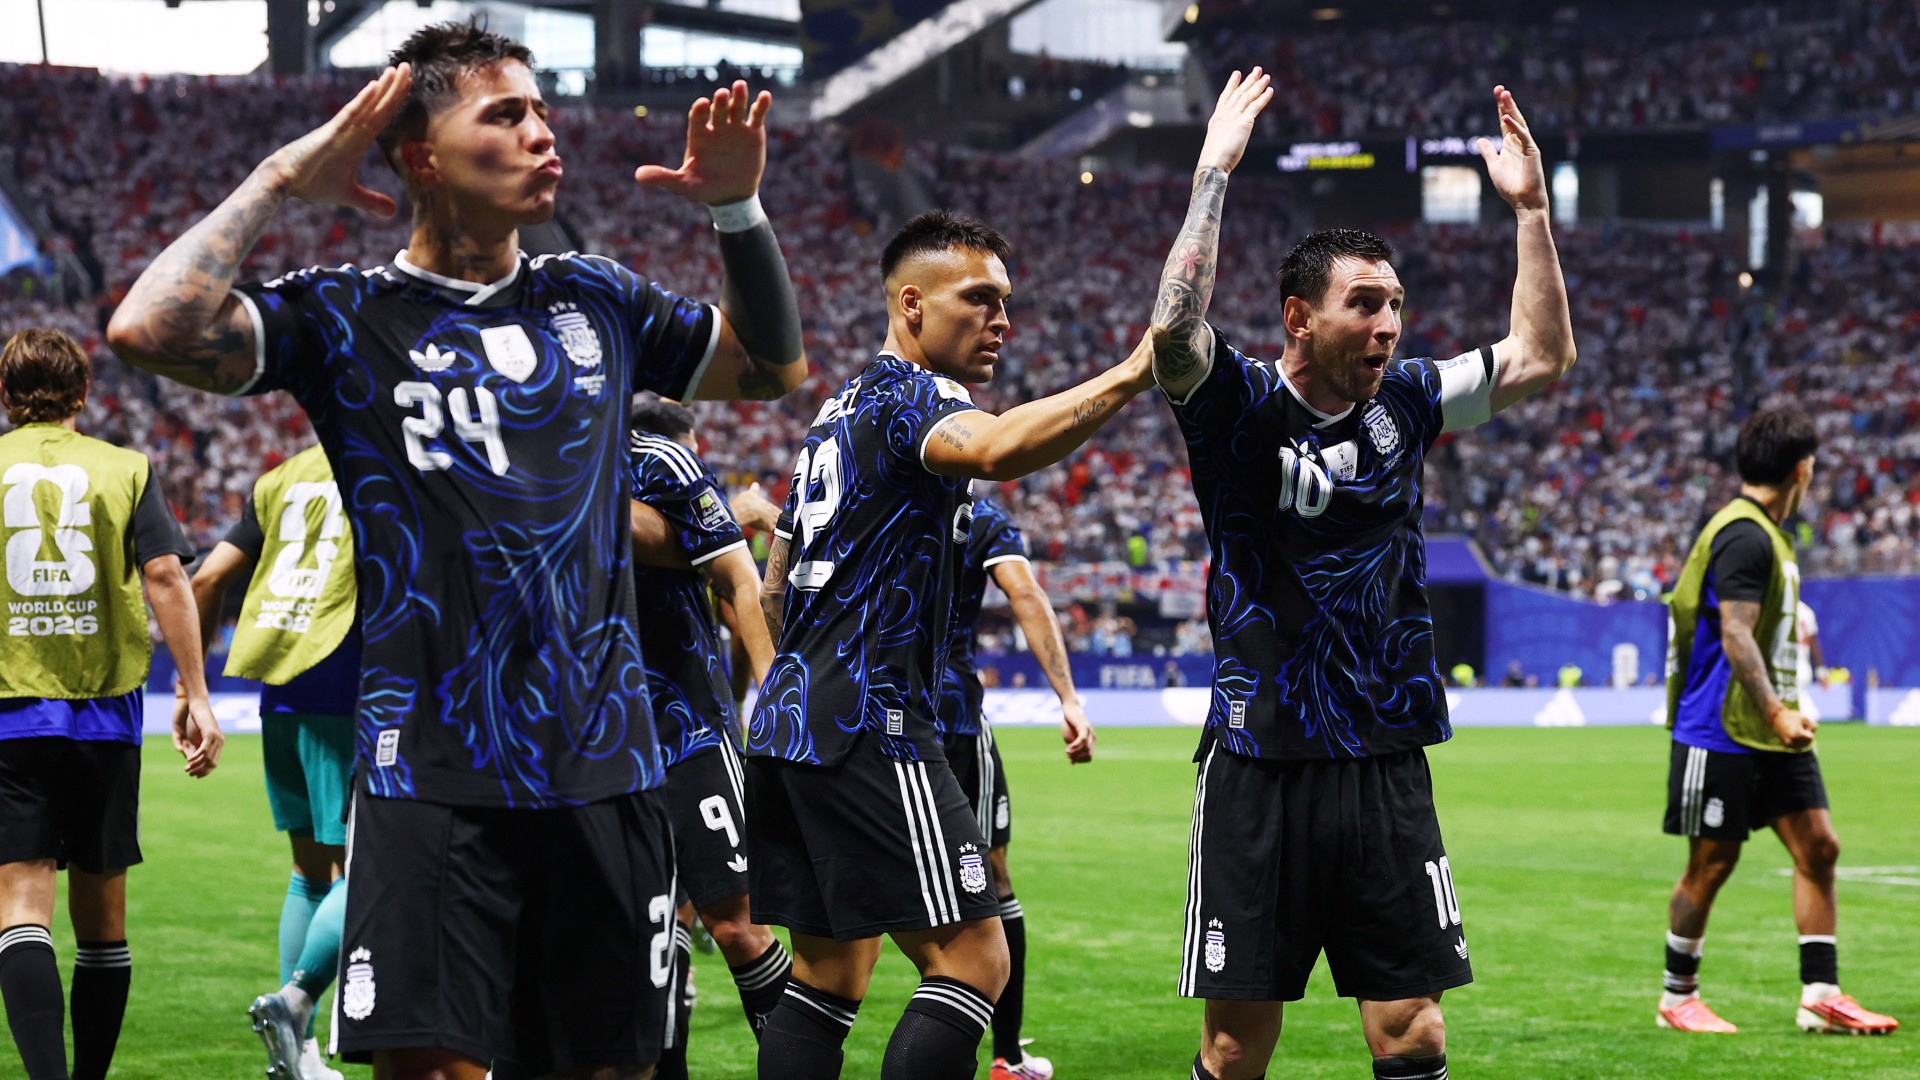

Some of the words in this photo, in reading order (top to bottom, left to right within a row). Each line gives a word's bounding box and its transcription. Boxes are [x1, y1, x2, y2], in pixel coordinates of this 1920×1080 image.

[394, 380, 510, 476] 24
[1340, 464, 1355, 474] FIFA
[1278, 446, 1334, 518] 10
[33, 568, 71, 583] FIFA
[8, 601, 64, 615] WORLD
[65, 600, 98, 613] CUP
[8, 615, 99, 637] 2026
[255, 612, 312, 634] 202
[1101, 664, 1156, 688] FIFA
[699, 794, 740, 848] 9
[1425, 855, 1463, 930] 10
[648, 894, 670, 988] 2
